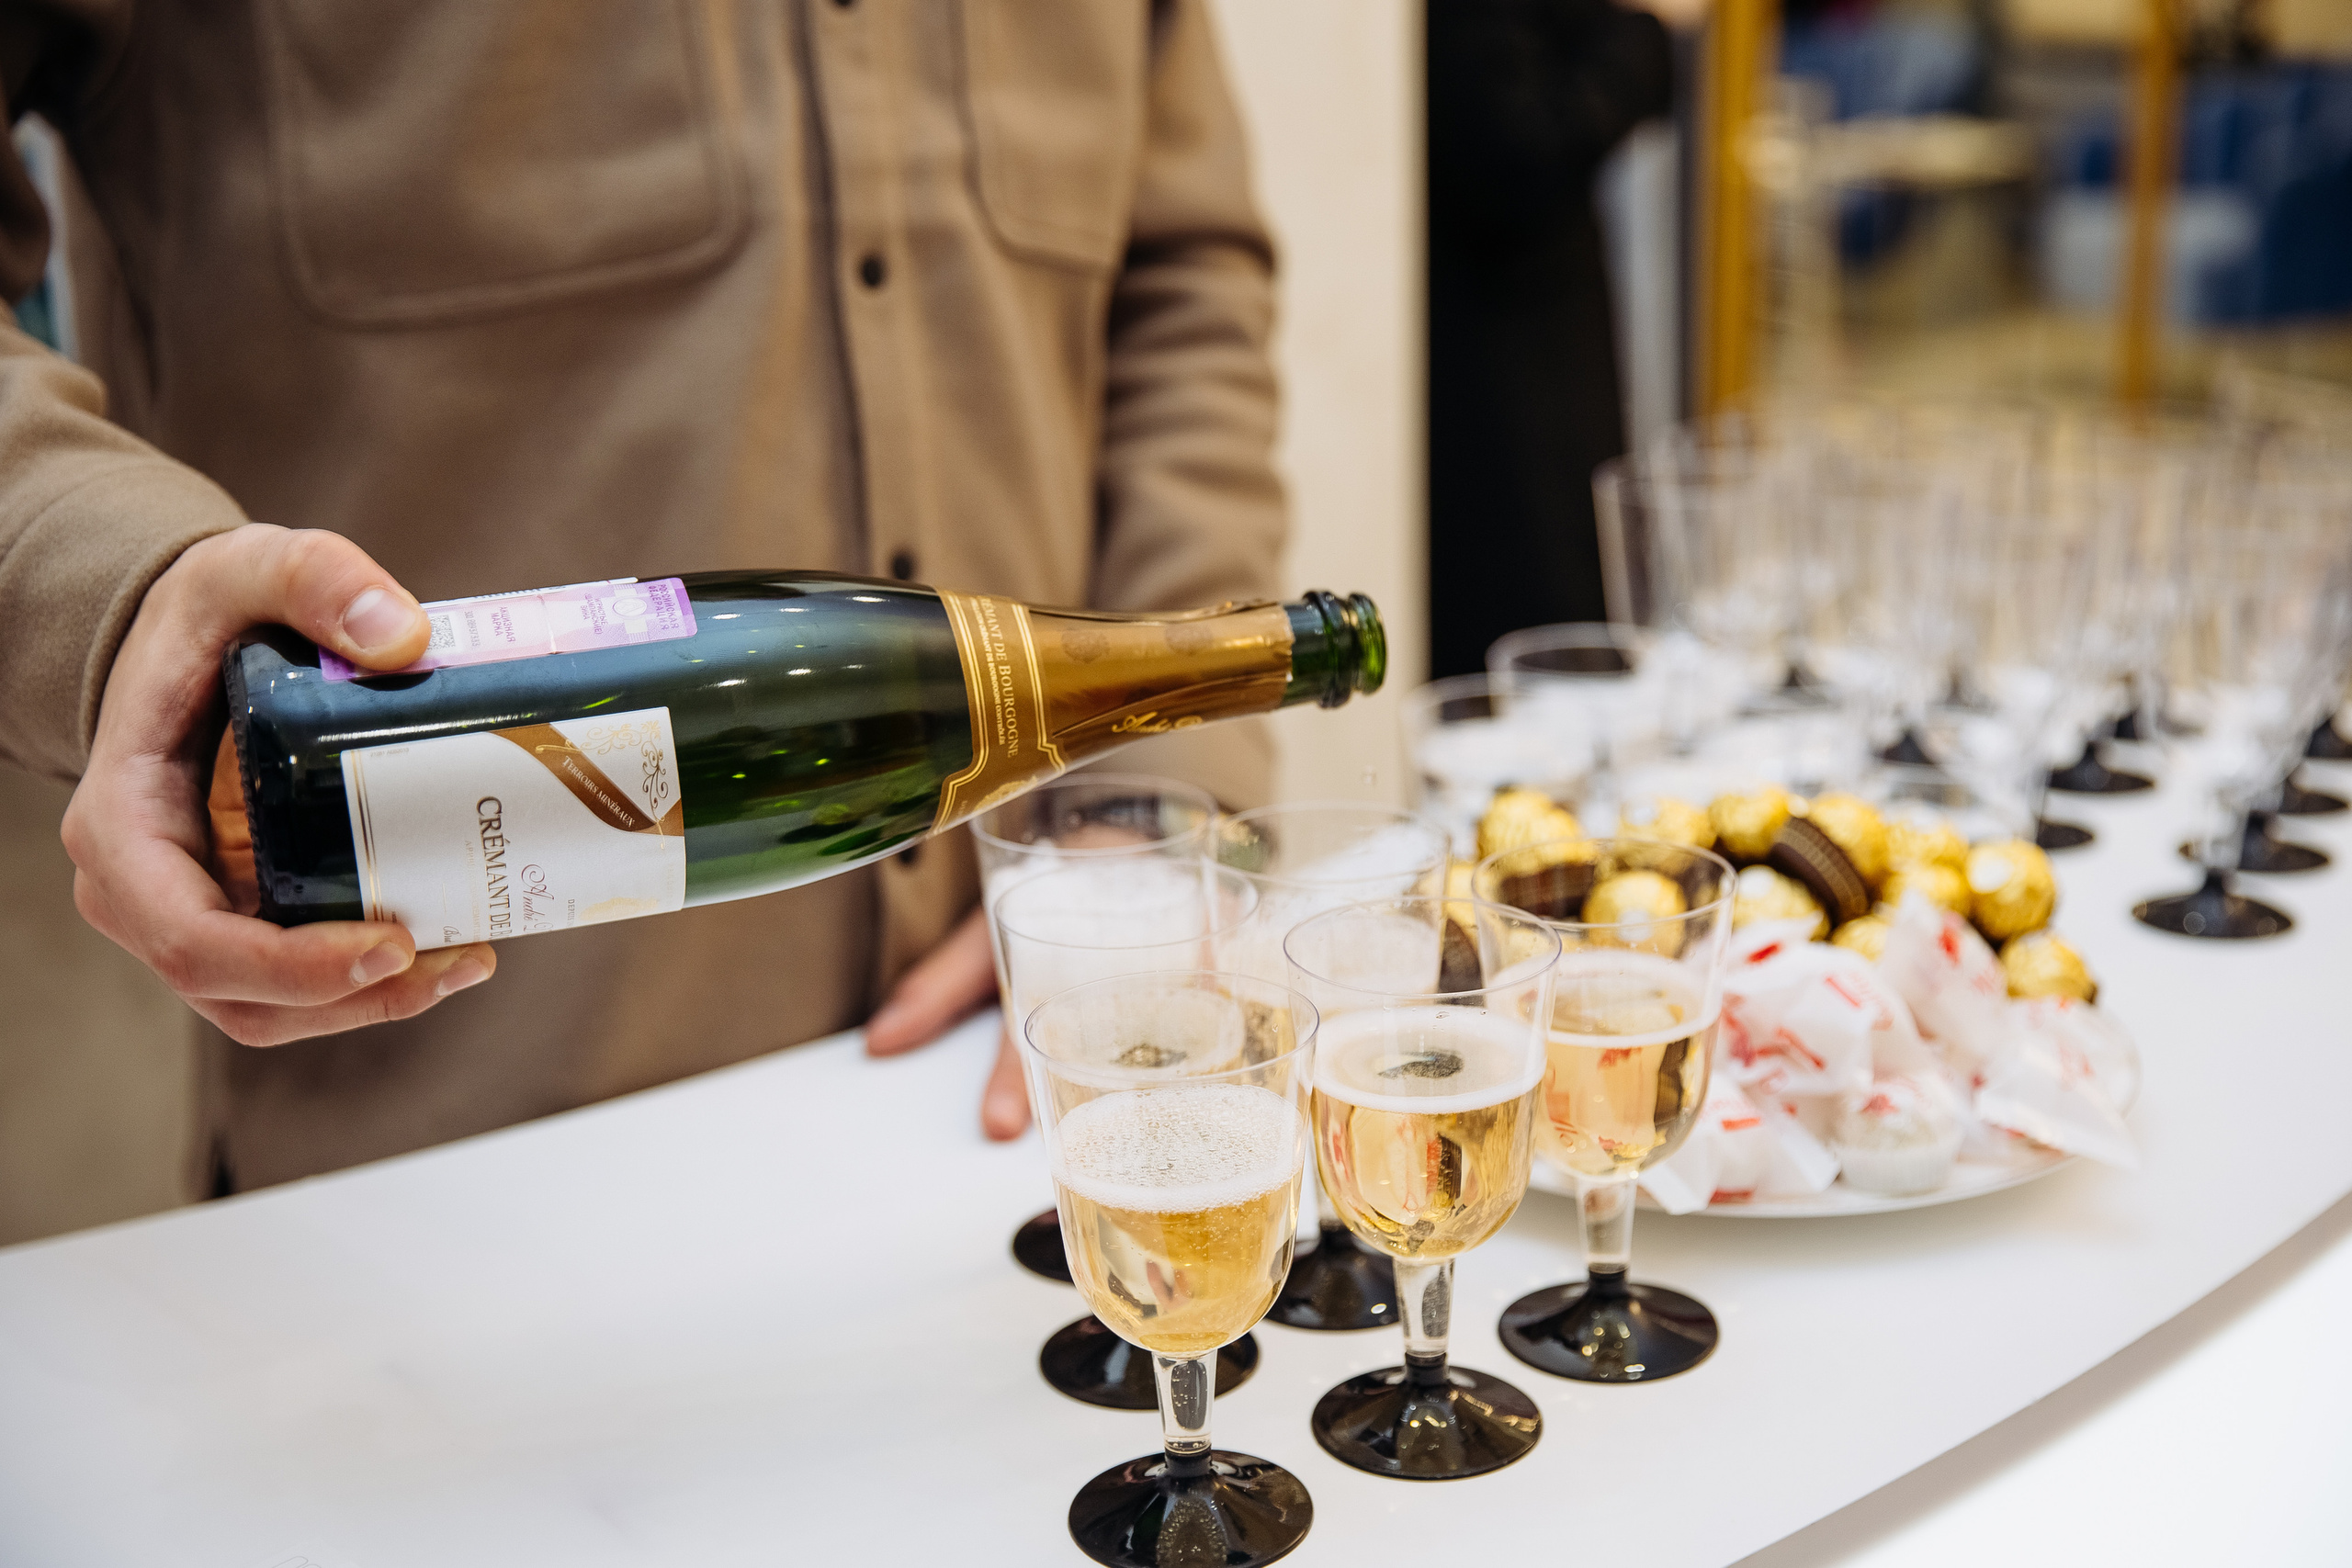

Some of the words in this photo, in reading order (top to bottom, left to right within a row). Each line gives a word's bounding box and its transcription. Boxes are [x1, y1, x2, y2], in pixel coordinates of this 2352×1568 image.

[491, 612, 504, 637] МАРКА
[499, 606, 516, 643] АКЦИЗНАЯ
[649, 585, 670, 630] ФЕДЕРАЦИЯ
[658, 583, 680, 629] РОССИЙСКАЯ
[993, 643, 1008, 661] DE
[999, 665, 1019, 758] BOURGOGNE
[596, 790, 636, 828] MINÉRAUX
[476, 795, 511, 909] CRÉMANT
[521, 863, 555, 921] André
[489, 911, 511, 931] DE
